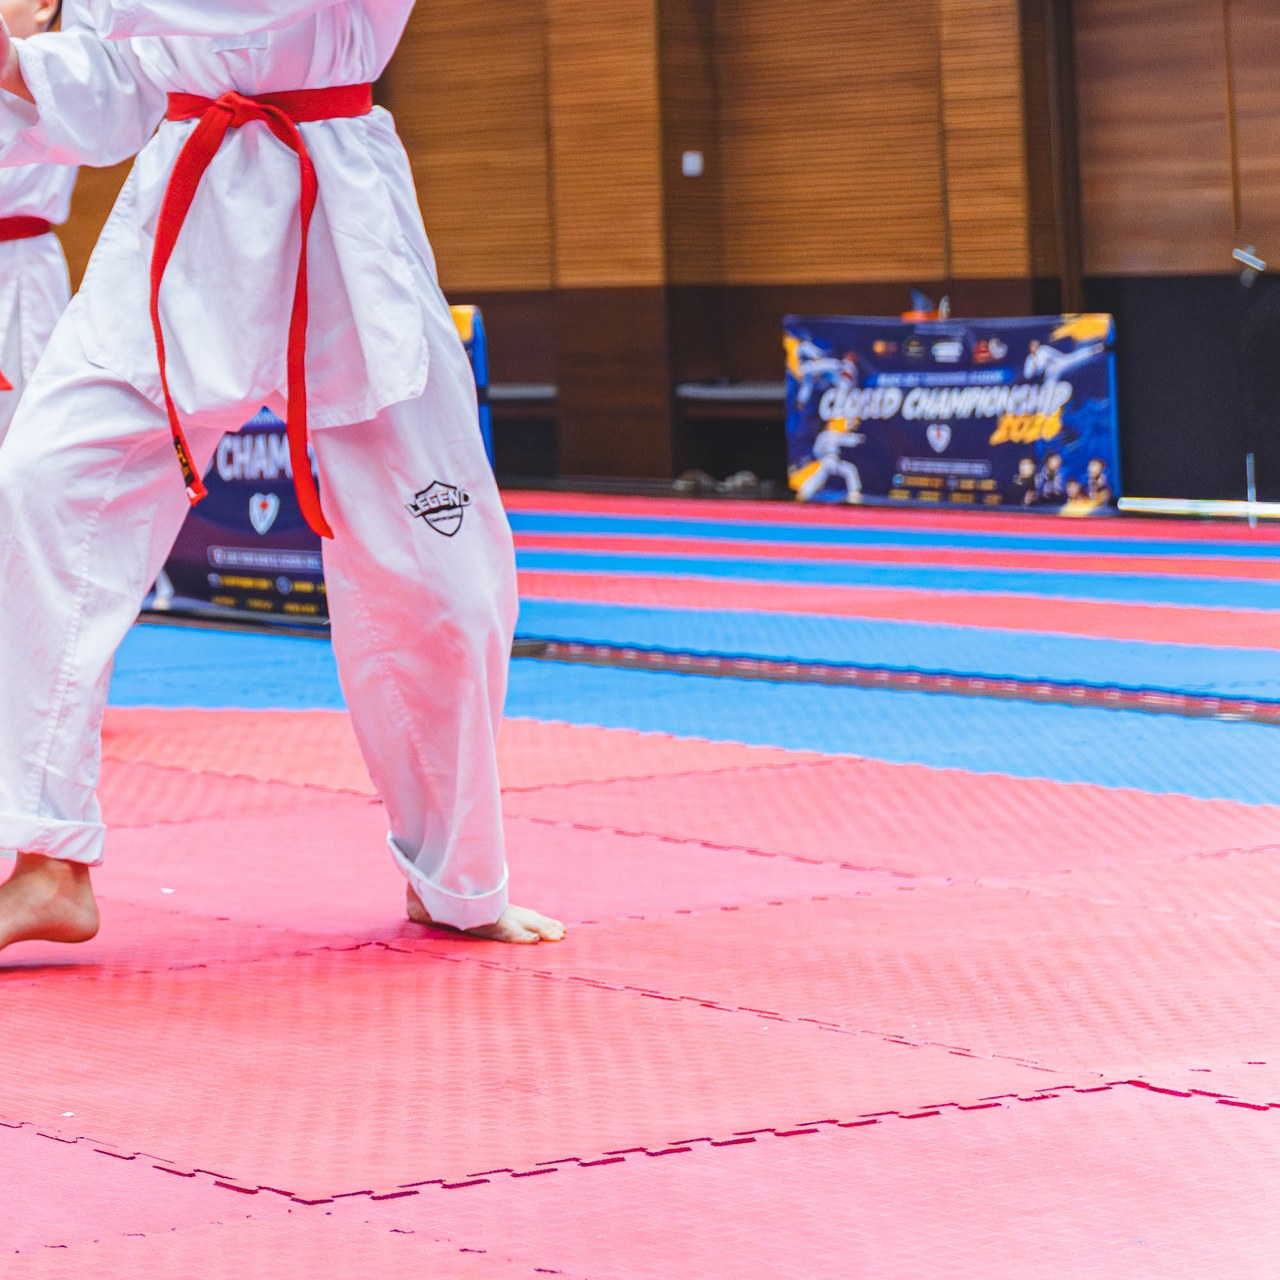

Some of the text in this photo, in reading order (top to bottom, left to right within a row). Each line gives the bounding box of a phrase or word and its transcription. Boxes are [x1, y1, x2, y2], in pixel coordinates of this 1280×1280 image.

[819, 380, 1074, 422] CLOSED CHAMPIONSHIP
[403, 489, 472, 518] LEGEND
